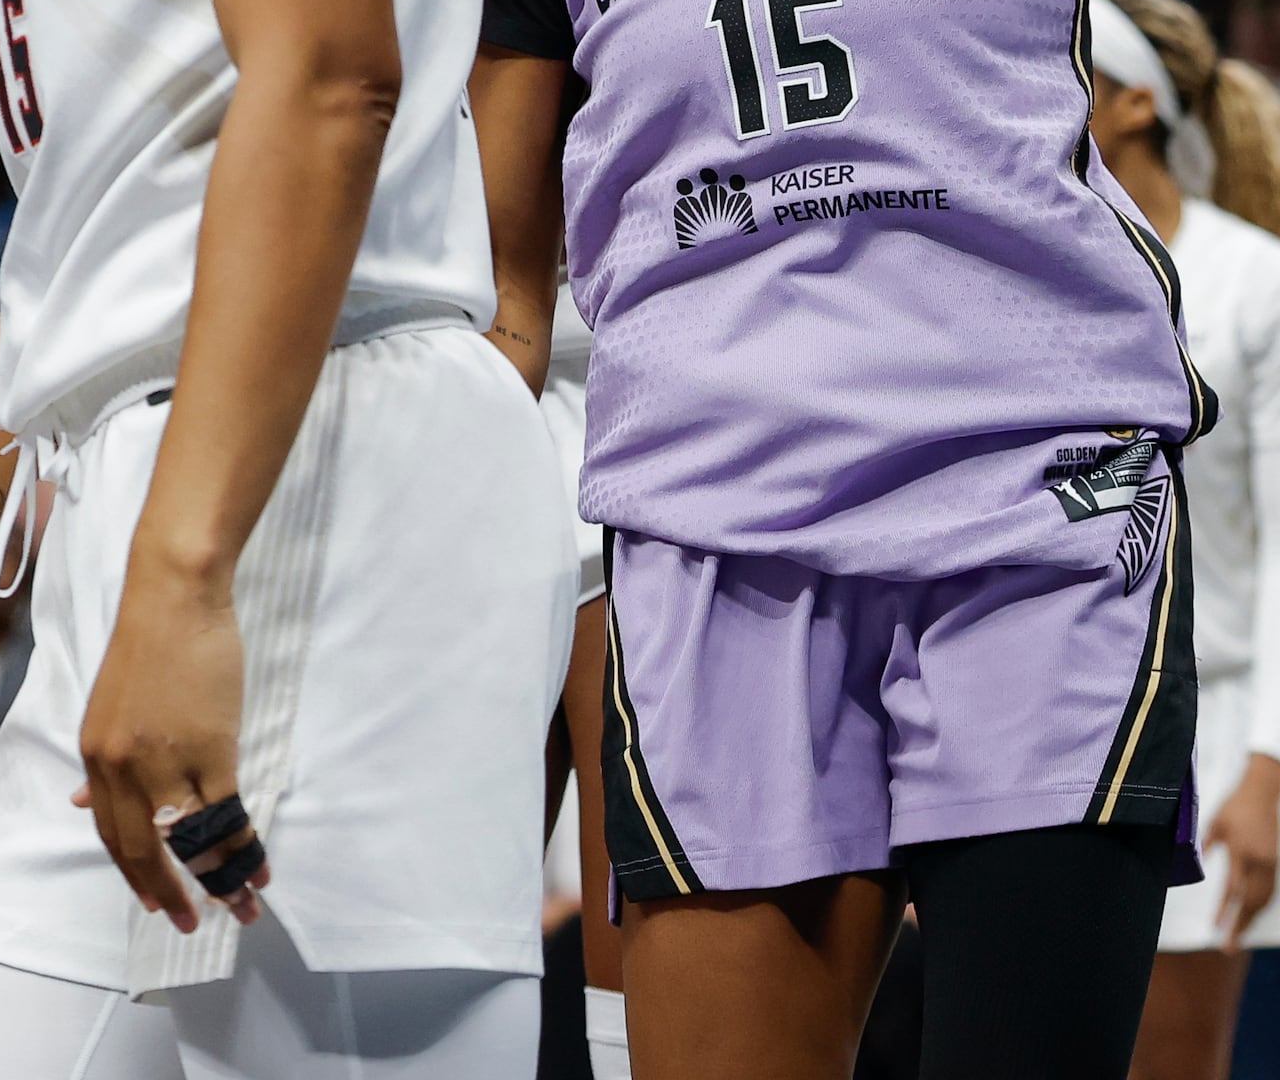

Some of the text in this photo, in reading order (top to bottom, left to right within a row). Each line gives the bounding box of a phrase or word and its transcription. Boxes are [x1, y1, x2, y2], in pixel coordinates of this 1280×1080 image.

[770, 164, 856, 196] KAISER
[773, 188, 952, 226] PERMANENTE
[1056, 446, 1097, 463] GOLDEN
